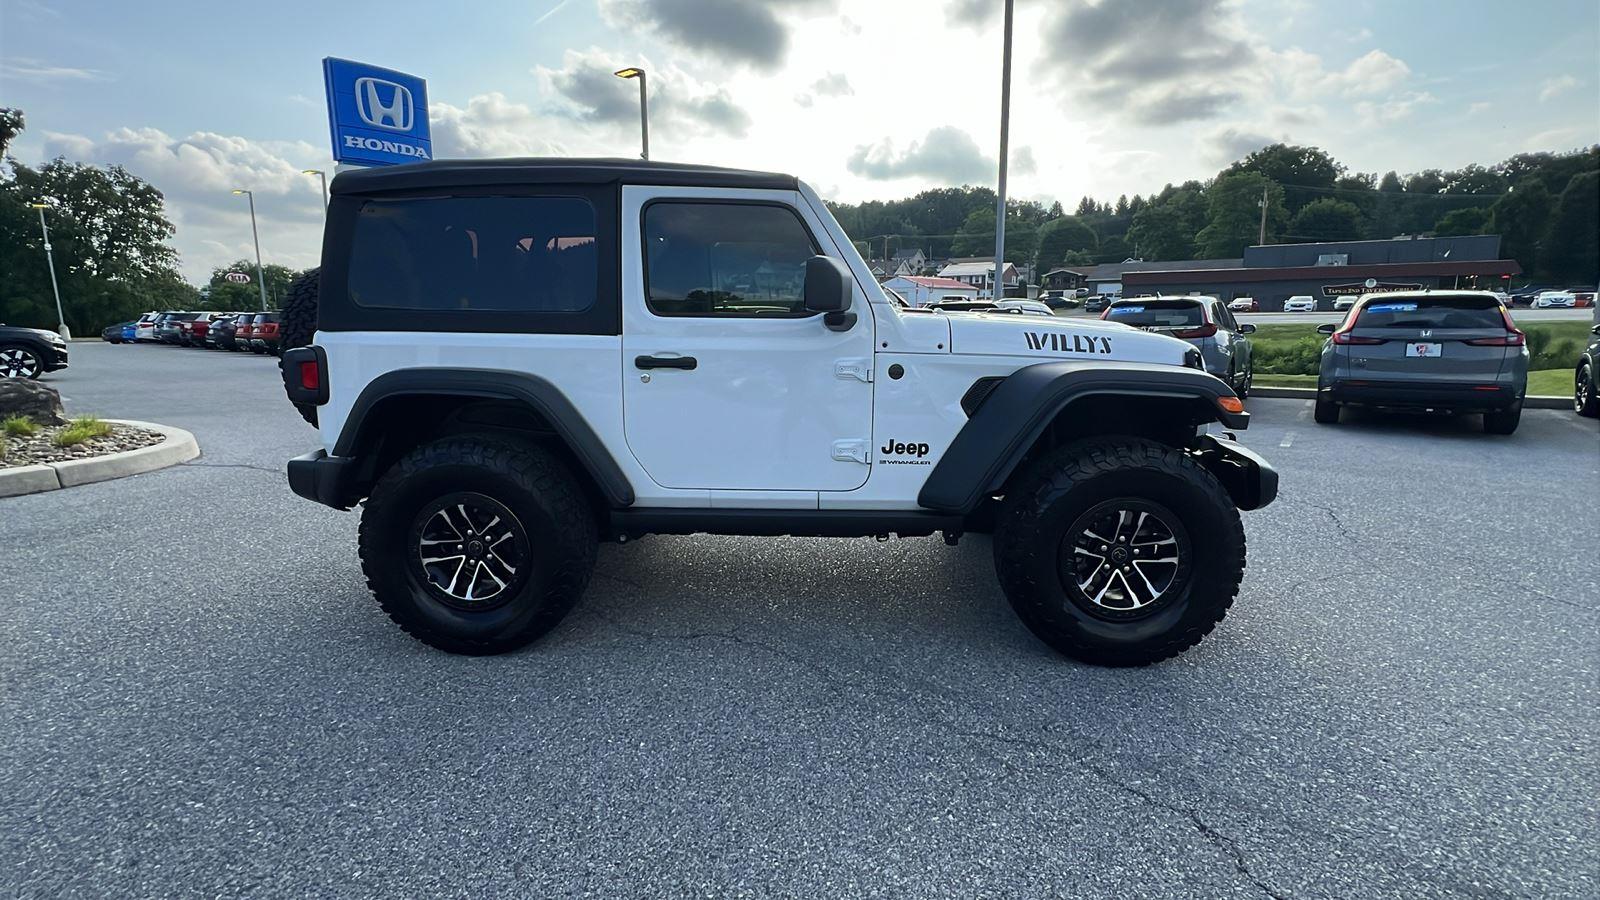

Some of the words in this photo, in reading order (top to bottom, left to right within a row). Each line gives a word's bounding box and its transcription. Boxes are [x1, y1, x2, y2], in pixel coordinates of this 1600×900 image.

[343, 136, 430, 159] HONDA
[1024, 332, 1112, 354] WILLYS
[881, 439, 930, 457] Jeep
